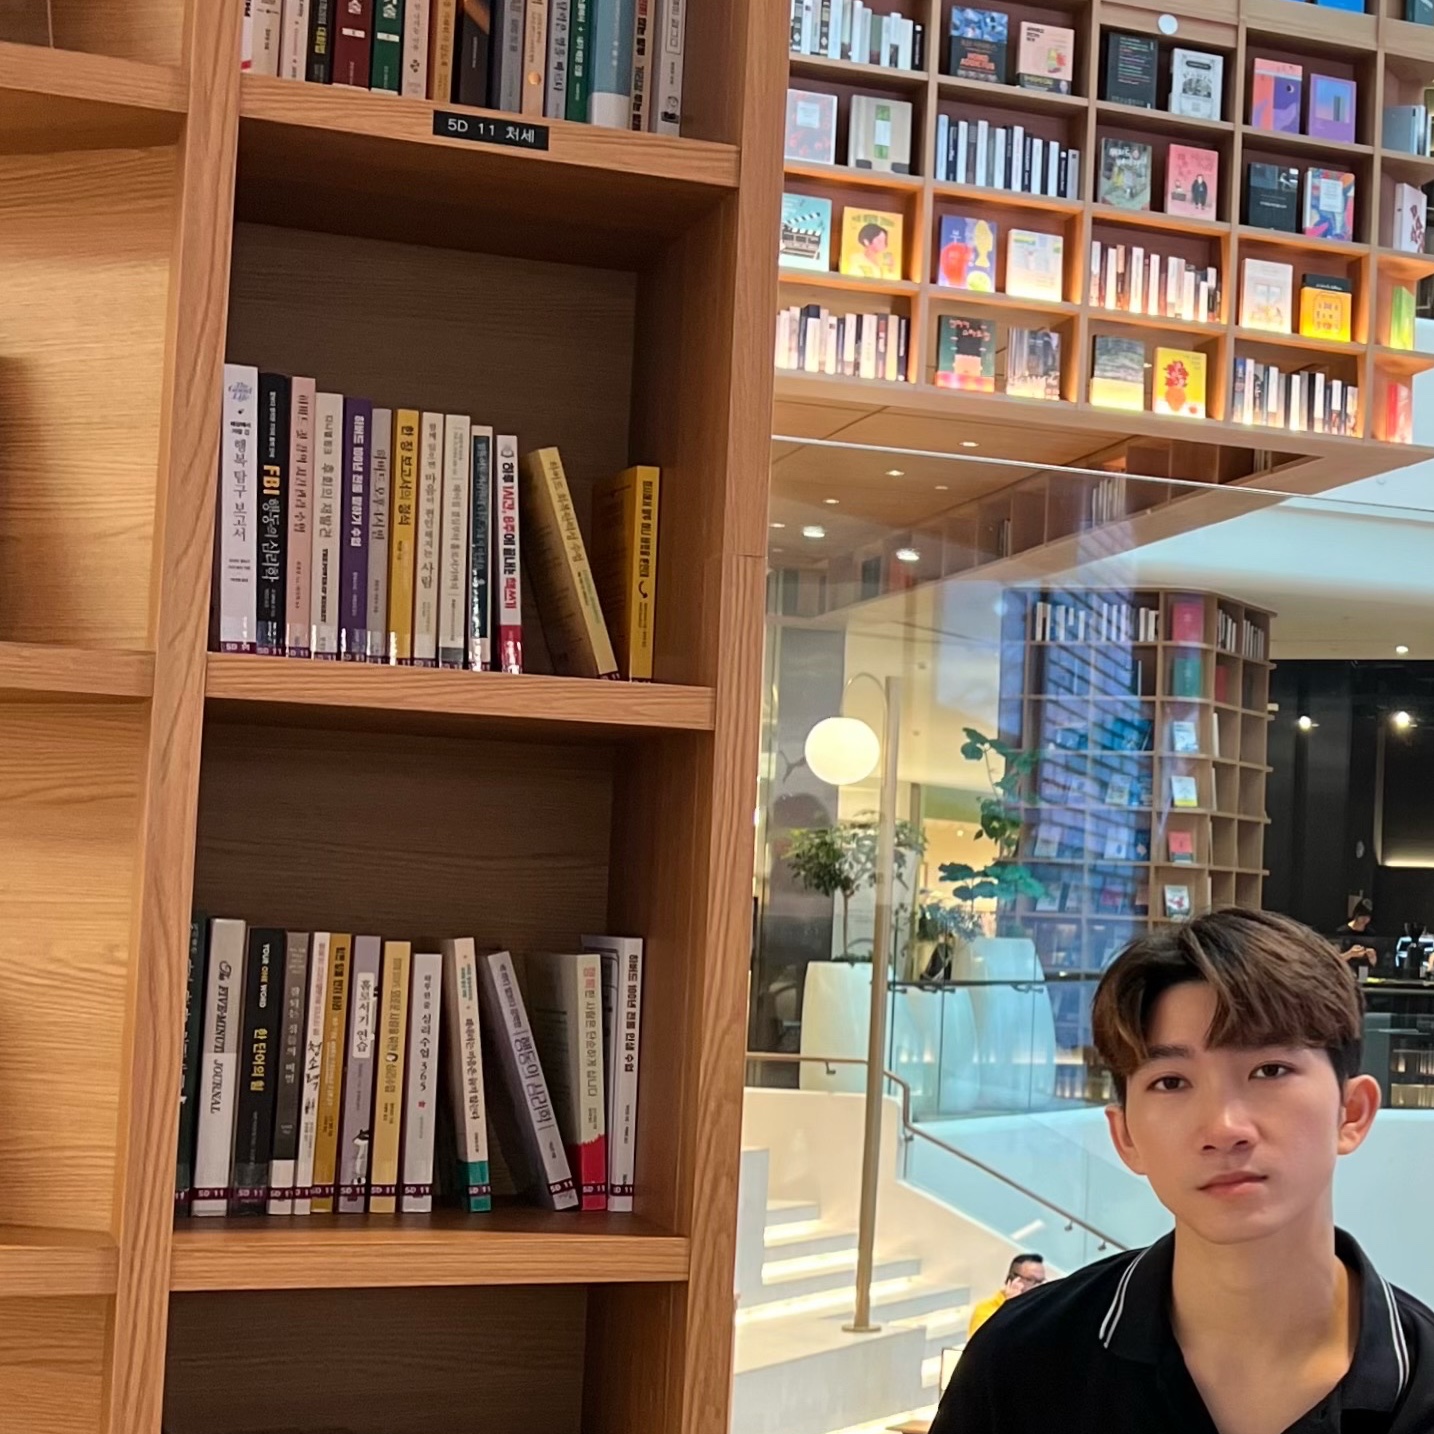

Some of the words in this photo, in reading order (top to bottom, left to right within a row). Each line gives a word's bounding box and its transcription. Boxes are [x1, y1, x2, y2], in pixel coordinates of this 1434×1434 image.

[447, 118, 469, 134] 5D
[480, 123, 496, 138] 11
[505, 125, 535, 145] 처세
[353, 415, 365, 444] 하버드
[401, 425, 414, 436] 한
[400, 440, 413, 452] 장
[263, 465, 281, 496] FBI
[398, 455, 412, 500] 보고서의
[502, 462, 515, 483] 하루
[502, 485, 515, 514] 1시간,
[262, 498, 280, 539] 행동의
[319, 502, 333, 539] 재발견
[397, 504, 411, 526] 정석
[351, 527, 362, 547] 수업
[503, 516, 516, 546] 8주에
[262, 540, 281, 583] 심리학
[503, 547, 516, 575] 끝내는
[504, 577, 517, 609] 책쓰기
[262, 943, 271, 964] YOUR
[218, 960, 232, 981] The
[260, 966, 269, 983] ONE
[627, 954, 638, 982] 하버드
[258, 984, 268, 1008] WORD
[255, 1028, 268, 1039] 한
[252, 1043, 266, 1077] 단어의
[624, 1053, 636, 1073] 수업
[210, 1059, 224, 1114] JOURNAL
[250, 1080, 265, 1091] 힘
[419, 1061, 428, 1092] 365
[526, 1082, 553, 1124] 심리학
[214, 1190, 224, 1198] 11
[355, 1187, 365, 1195] 11
[404, 1187, 417, 1195] 5D
[420, 1186, 430, 1194] 11
[563, 1180, 573, 1188] 11
[596, 1185, 606, 1193] 11
